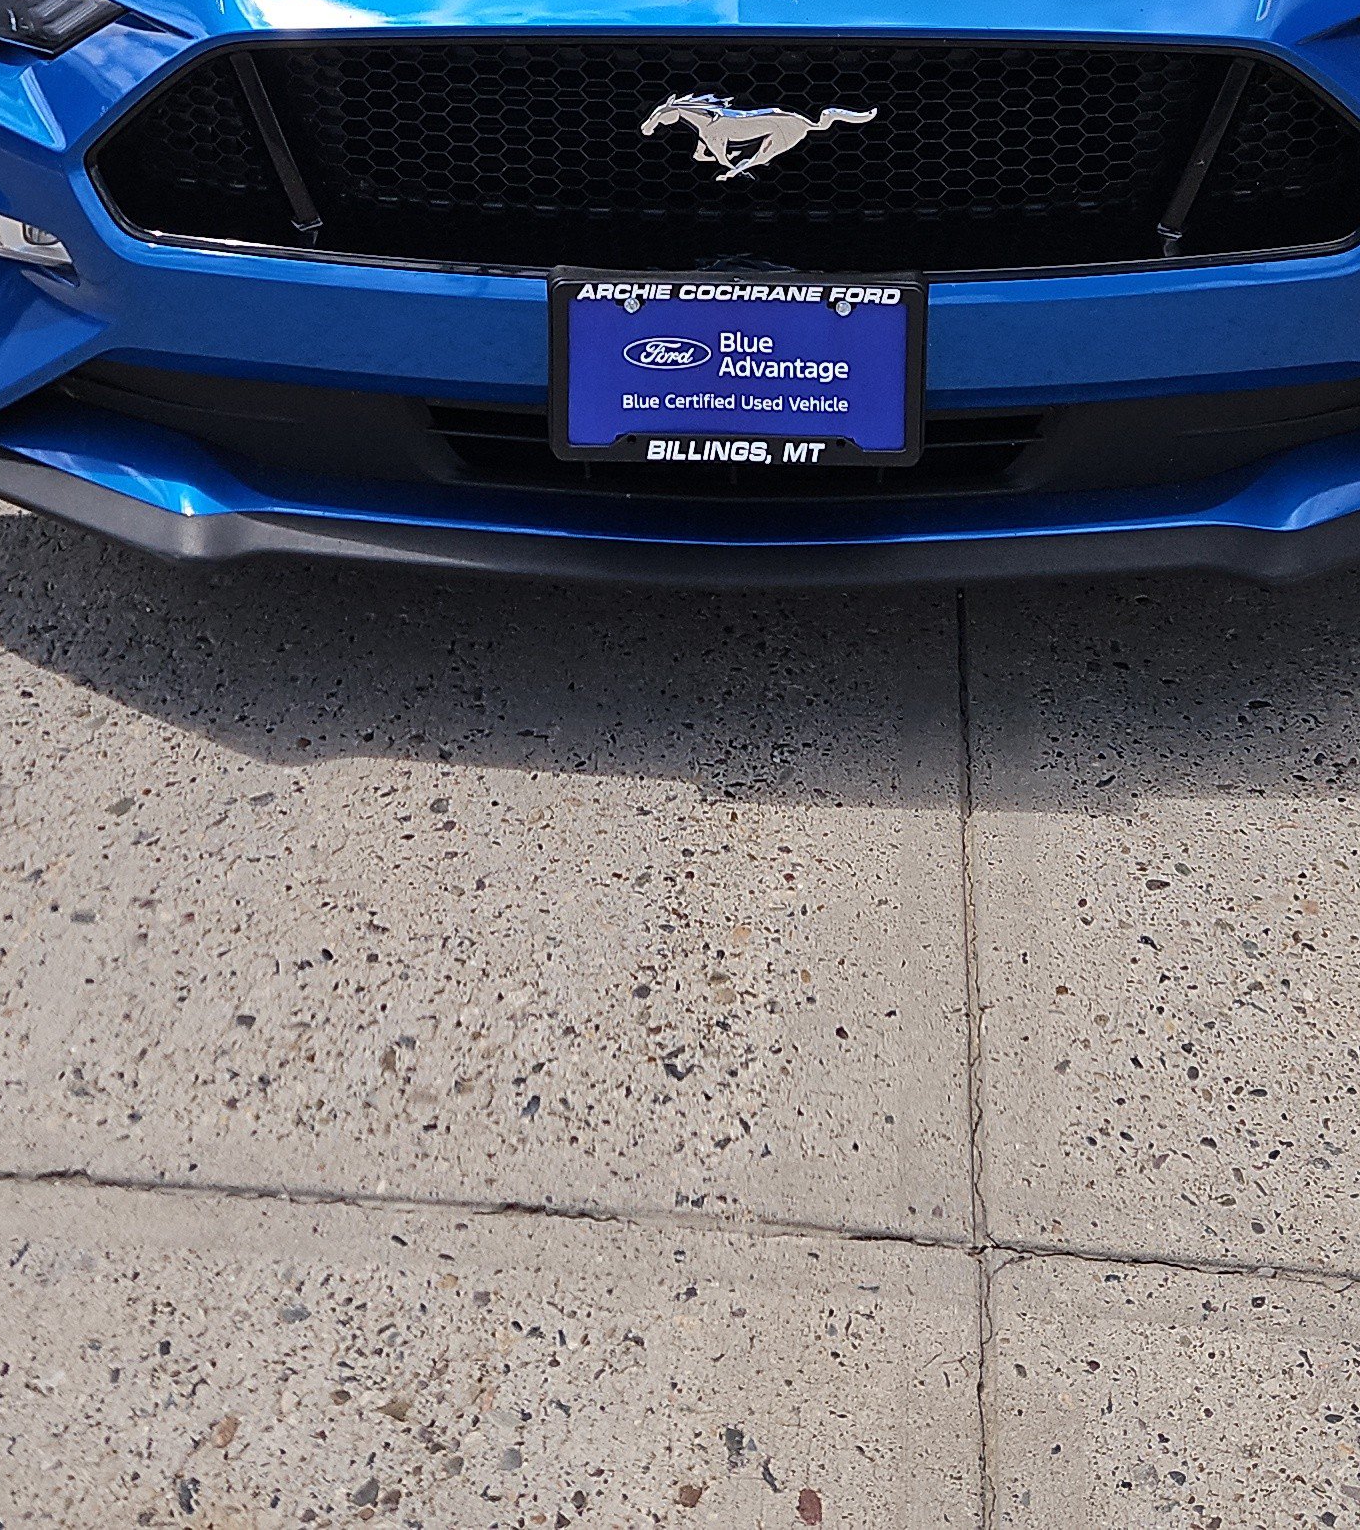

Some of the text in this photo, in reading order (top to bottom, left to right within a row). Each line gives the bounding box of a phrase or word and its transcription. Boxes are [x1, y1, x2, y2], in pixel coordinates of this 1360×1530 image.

[576, 283, 902, 305] ARCHIE COCHRANE FORD
[639, 340, 695, 364] Ford
[719, 331, 773, 353] Blue
[718, 355, 849, 383] Advantage
[622, 393, 849, 412] Blue Certified Used Vehicle
[646, 439, 826, 464] BILLINGS, MT
